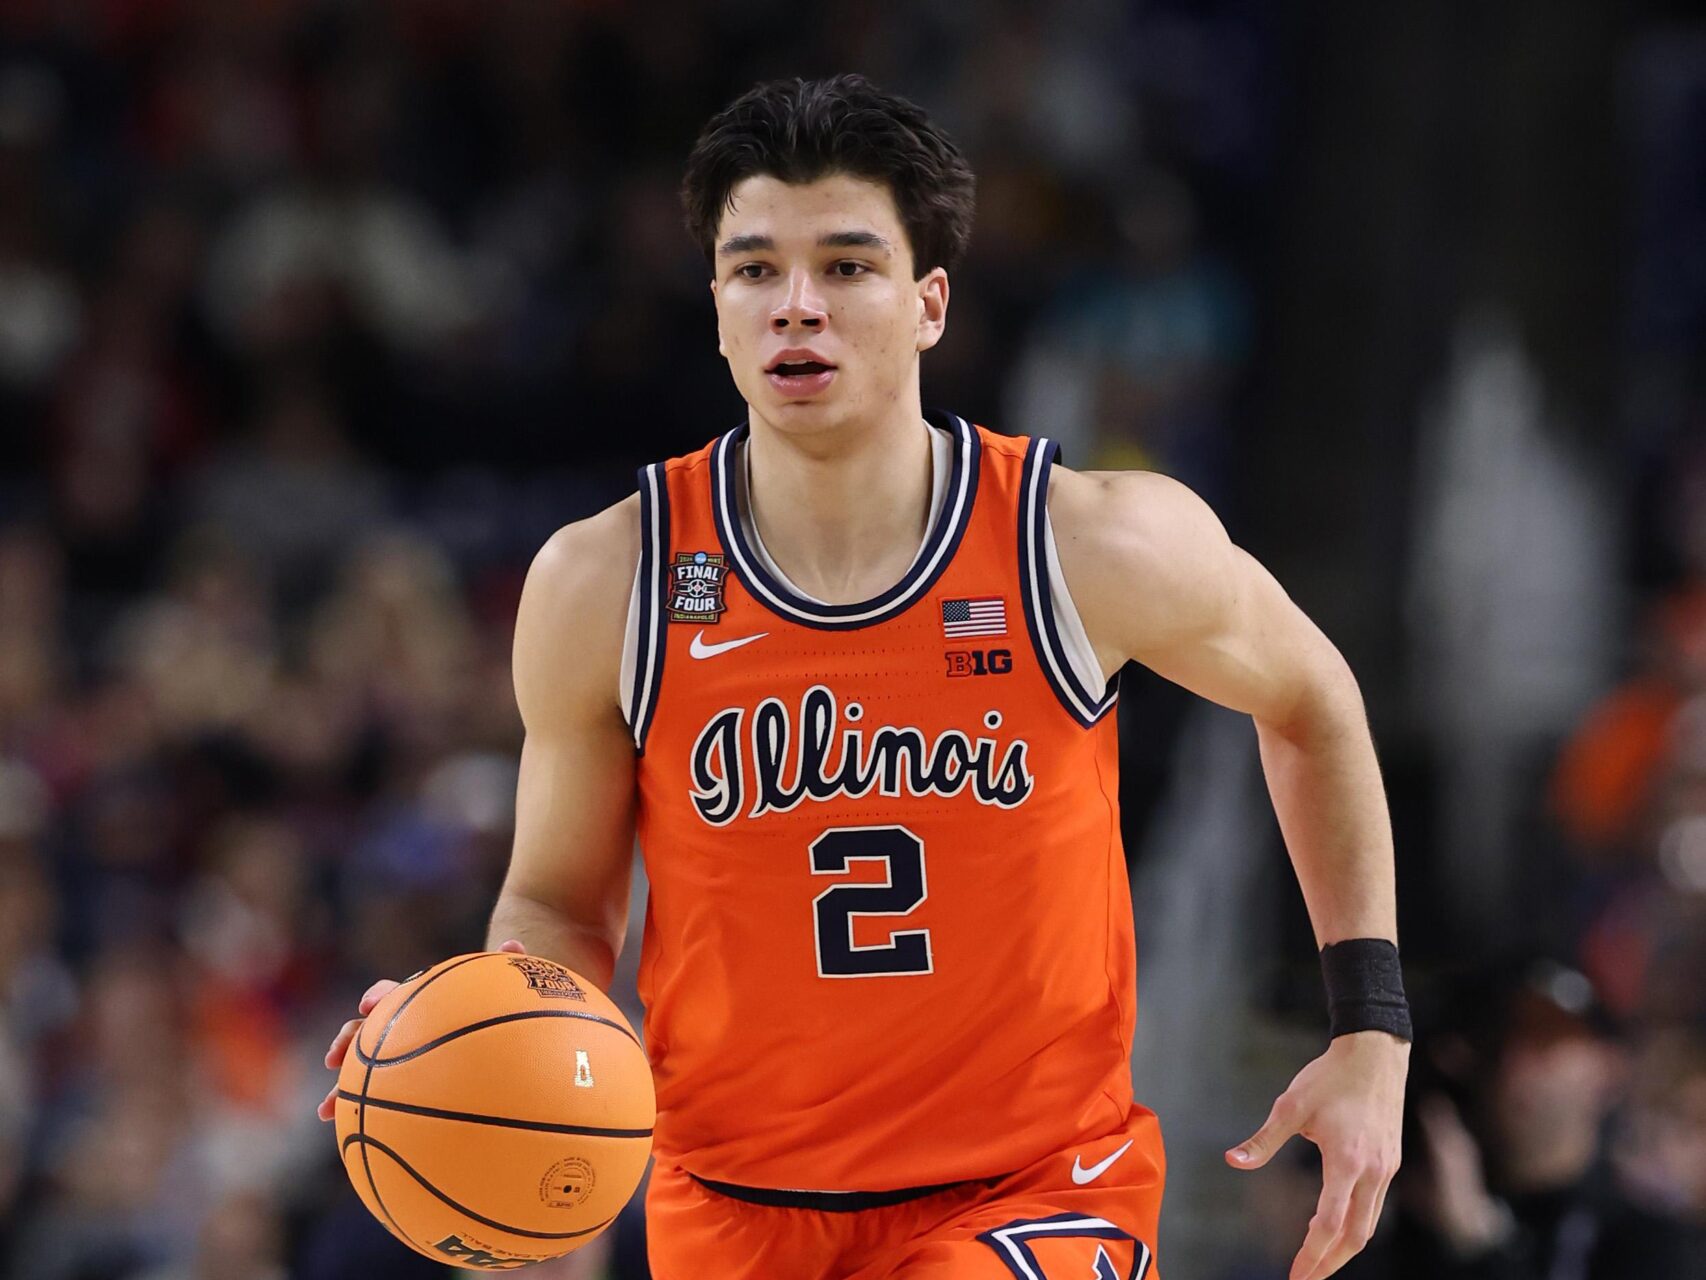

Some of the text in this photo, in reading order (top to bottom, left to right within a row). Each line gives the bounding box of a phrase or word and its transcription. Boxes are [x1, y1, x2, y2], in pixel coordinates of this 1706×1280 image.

[675, 597, 715, 611] FOUR
[678, 566, 718, 580] FINAL
[689, 684, 1034, 827] Illinois
[807, 824, 934, 978] 2
